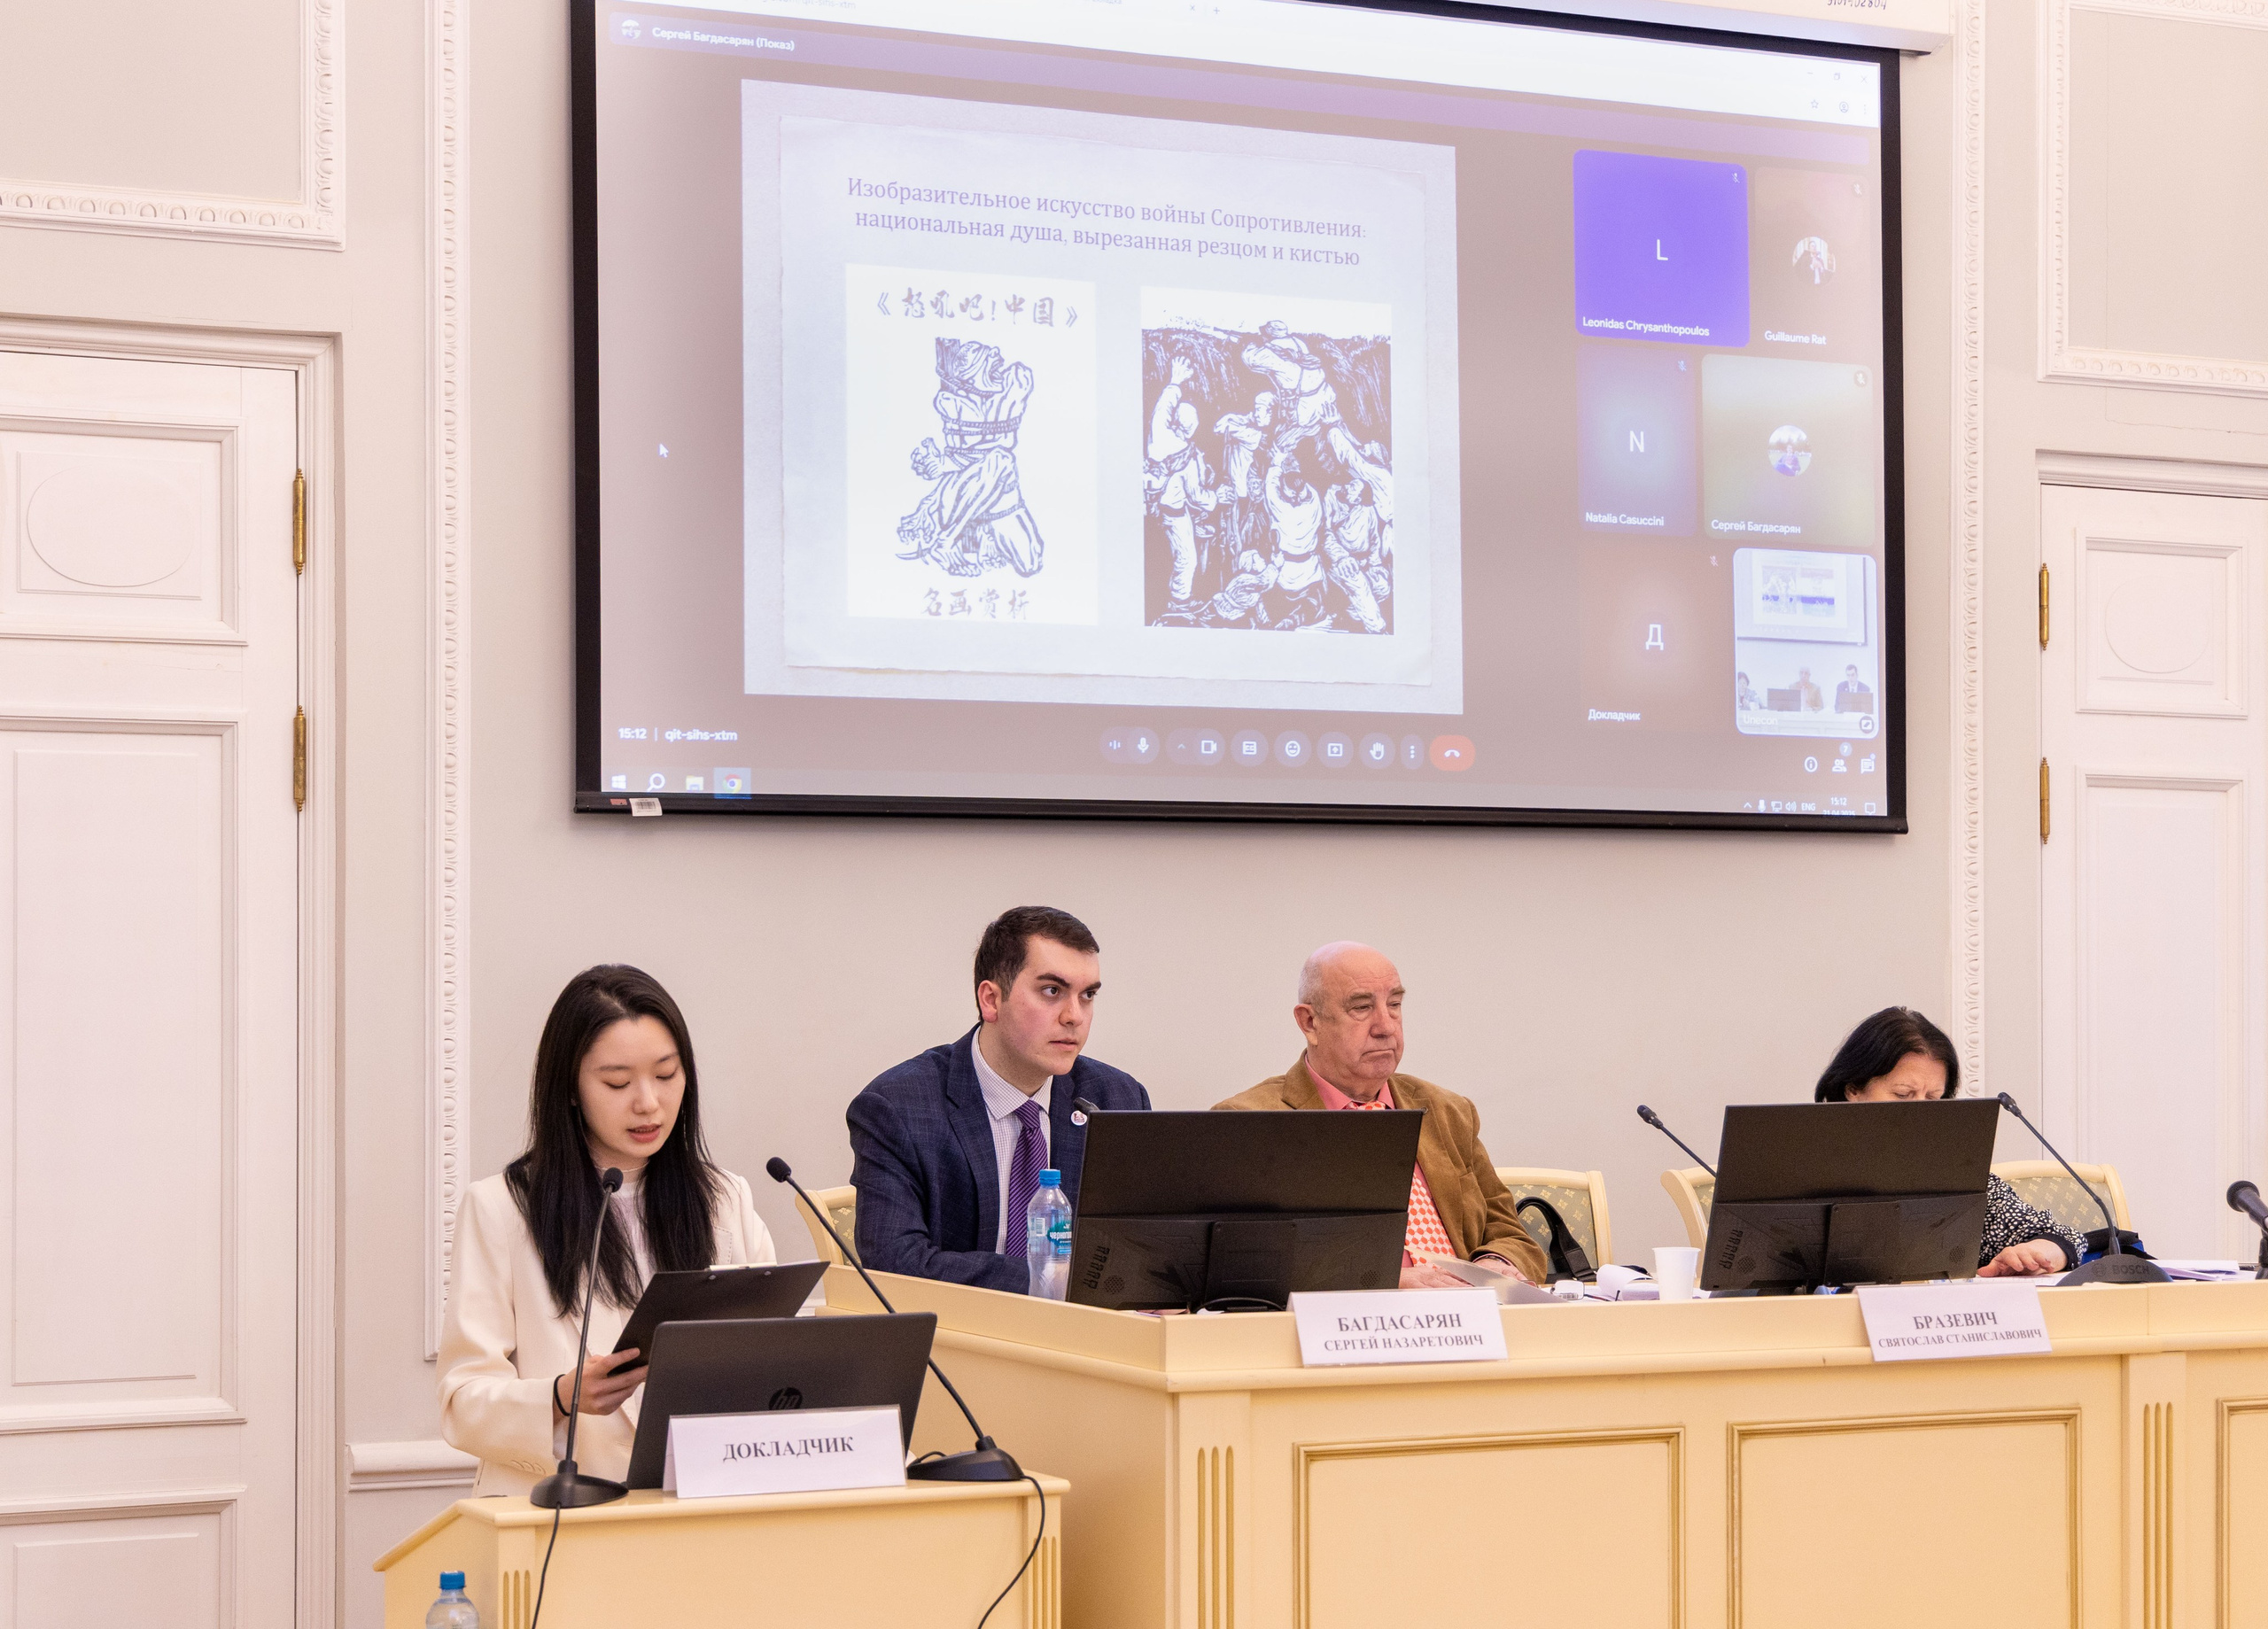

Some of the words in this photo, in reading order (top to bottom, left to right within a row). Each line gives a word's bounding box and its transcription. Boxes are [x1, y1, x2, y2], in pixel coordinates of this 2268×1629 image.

[651, 27, 692, 41] Сергей
[693, 31, 754, 47] Багдасарян
[756, 36, 796, 51] (Показ)
[847, 177, 1031, 210] Изобразительное
[1036, 196, 1135, 220] искусство
[1140, 204, 1206, 225] войны
[1210, 208, 1367, 238] Сопротивления:
[855, 212, 1005, 237] национальная
[1010, 223, 1068, 246] душа,
[1073, 229, 1192, 252] вырезанная
[1197, 239, 1267, 260] резцом
[1272, 245, 1284, 260] и
[1289, 247, 1360, 266] кистью
[1656, 238, 1668, 261] L
[1582, 316, 1625, 330] Leonidas
[1626, 320, 1710, 337] Chrysanthopoulos
[1764, 330, 1810, 345] Guillaume
[1811, 334, 1827, 345] Rat
[1629, 431, 1645, 454] N
[1585, 512, 1618, 525] Natalia
[1619, 514, 1665, 527] Casuccini
[1711, 519, 1746, 532] Сергей
[1747, 521, 1801, 535] Багдасарян
[920, 586, 1030, 620] 名画赏析
[1645, 624, 1664, 651] Д
[1588, 709, 1641, 722] Докладчик
[617, 727, 648, 740] 15:12
[664, 728, 738, 742] qit-sihs-xtm
[1800, 802, 1816, 811] ENG
[1830, 796, 1847, 806] 15:12
[2111, 1264, 2149, 1275] BOSCH
[1337, 1313, 1463, 1333] БАГДАСАРЯН
[1912, 1311, 1999, 1330] БРАЗЕВИЧ
[1324, 1336, 1379, 1352] СЕРГЕЙ
[1382, 1334, 1484, 1350] НАЗАРЕТОВИЧ
[1878, 1336, 1945, 1348] СВЯТОСЛАВ
[1946, 1329, 2043, 1344] СТАНИСЛАВОВИЧ
[770, 1388, 802, 1409] hp
[723, 1436, 854, 1462] ДОКЛАДЧИК
